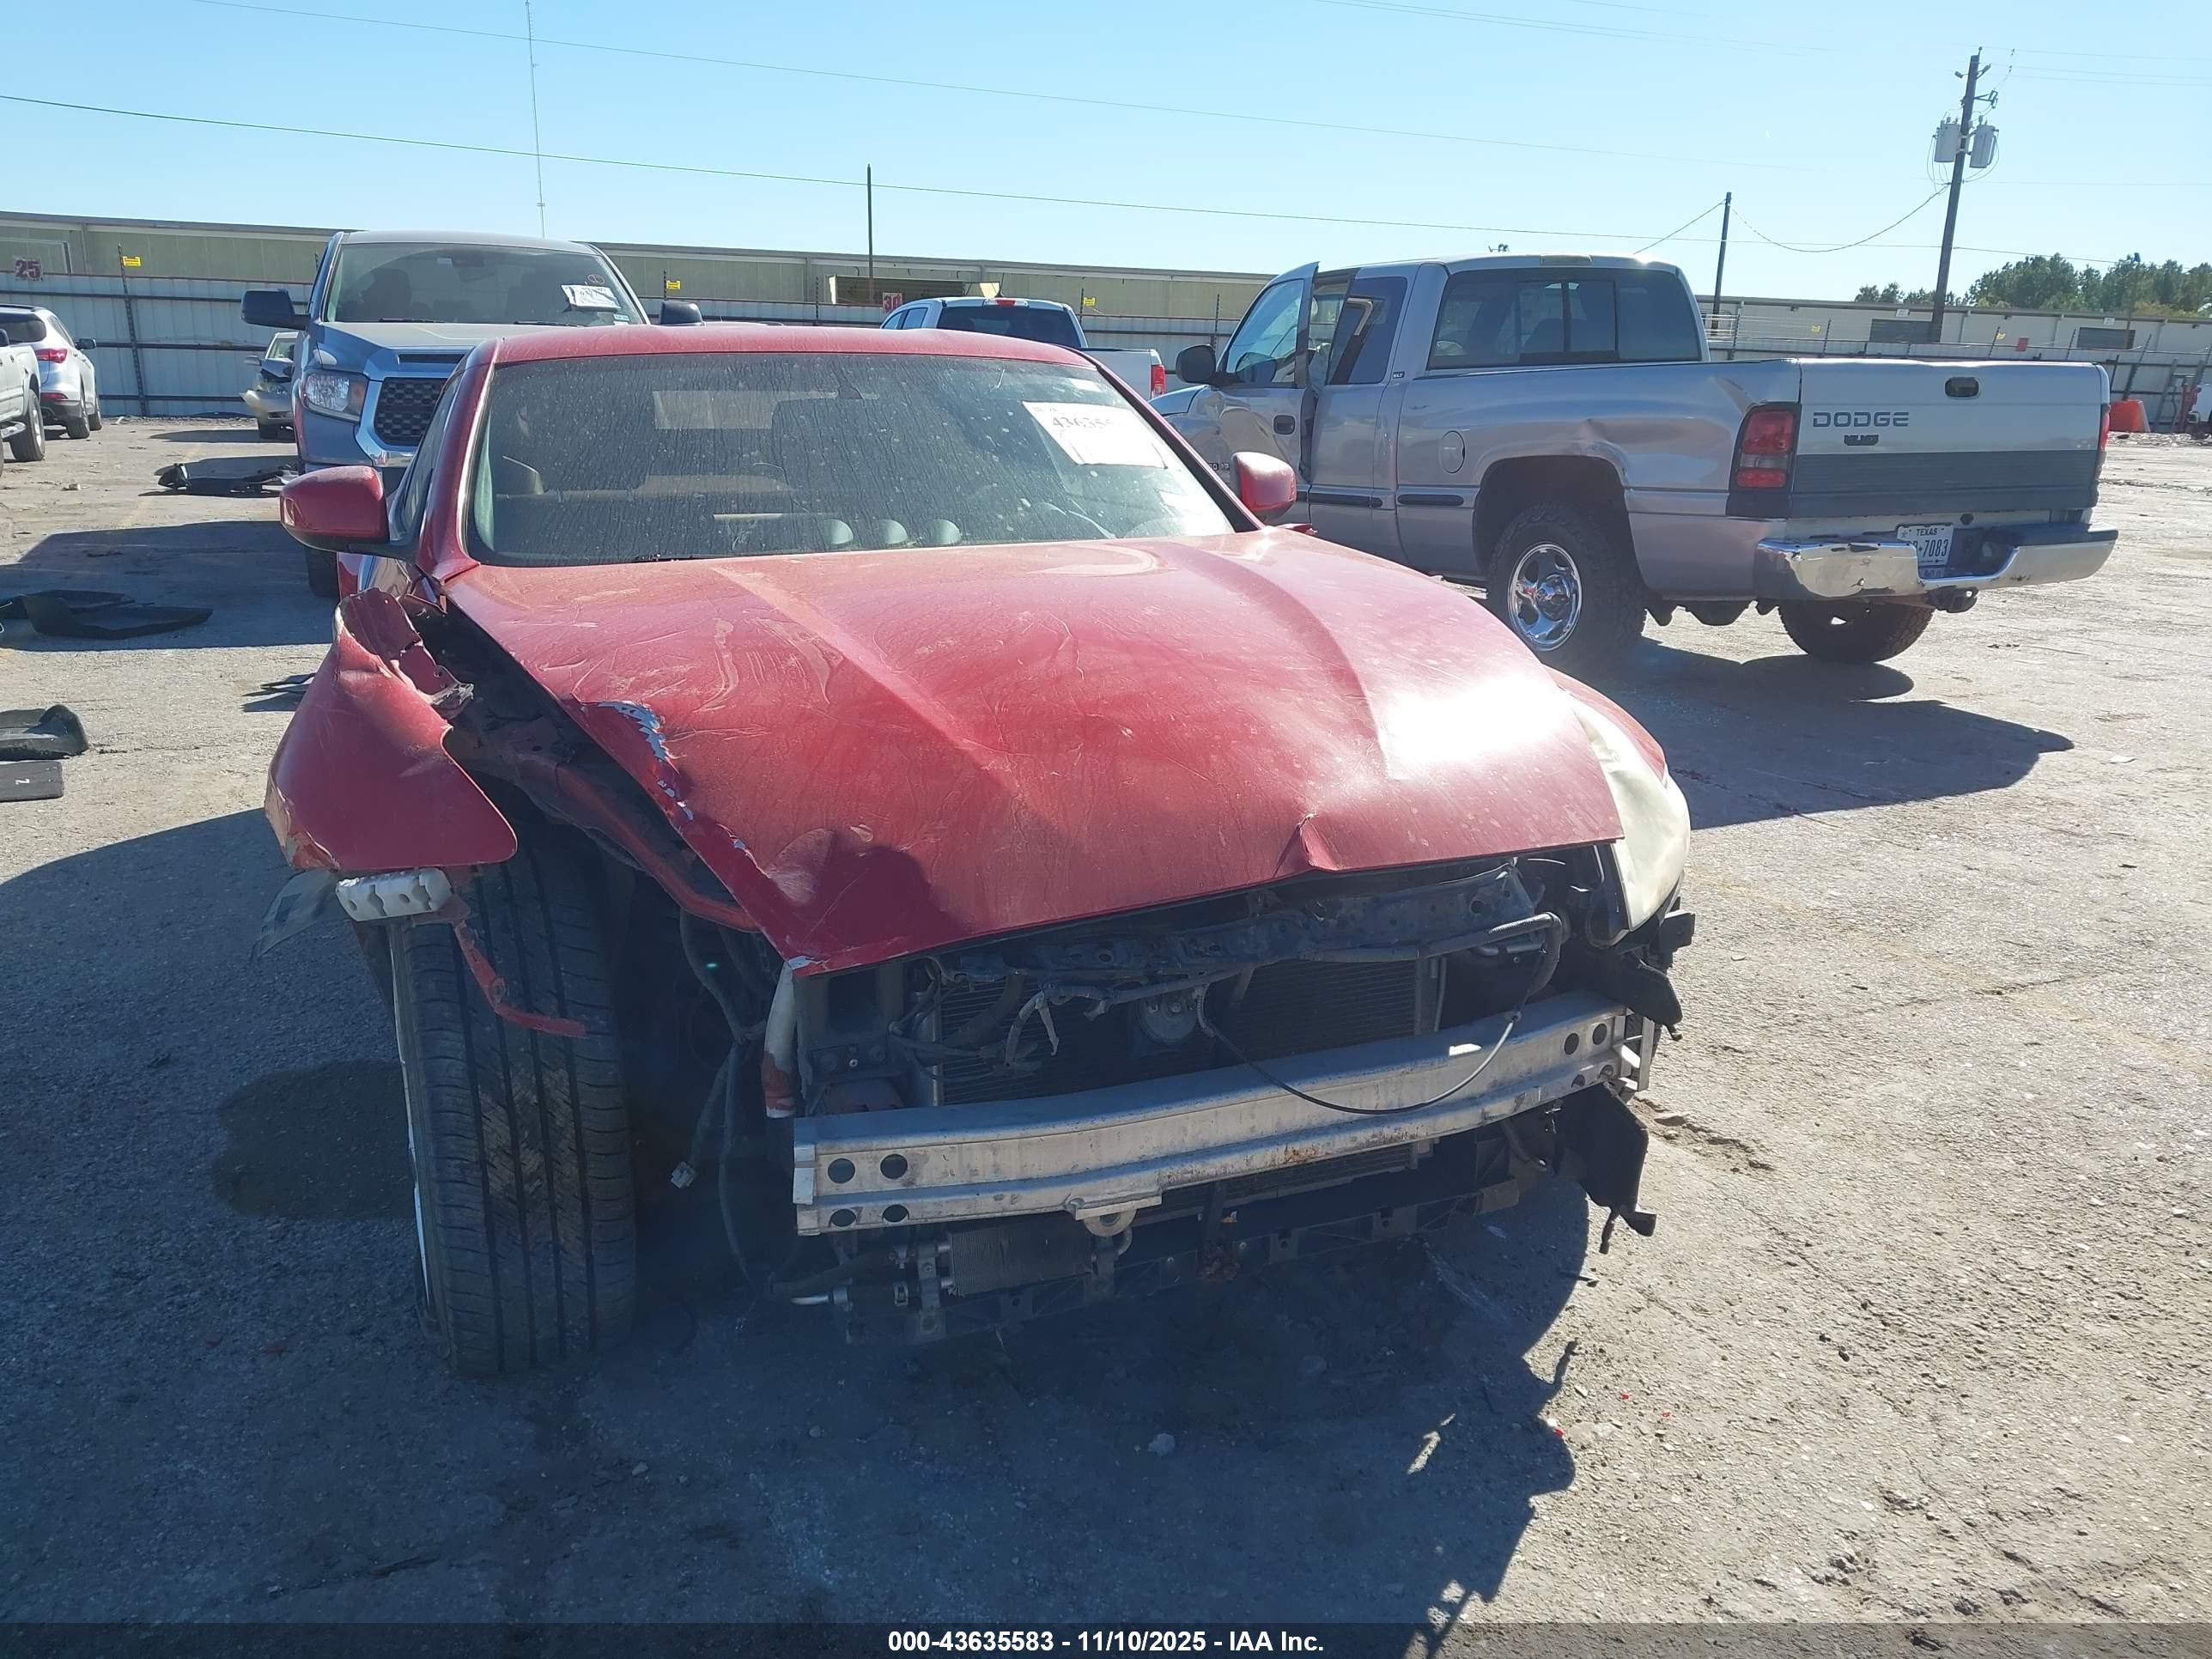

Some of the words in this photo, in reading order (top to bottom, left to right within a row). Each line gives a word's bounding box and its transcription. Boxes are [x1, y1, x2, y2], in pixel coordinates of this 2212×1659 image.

[15, 259, 42, 281] 25
[1813, 411, 1910, 428] DODGE
[1917, 528, 1938, 537] TEXAS
